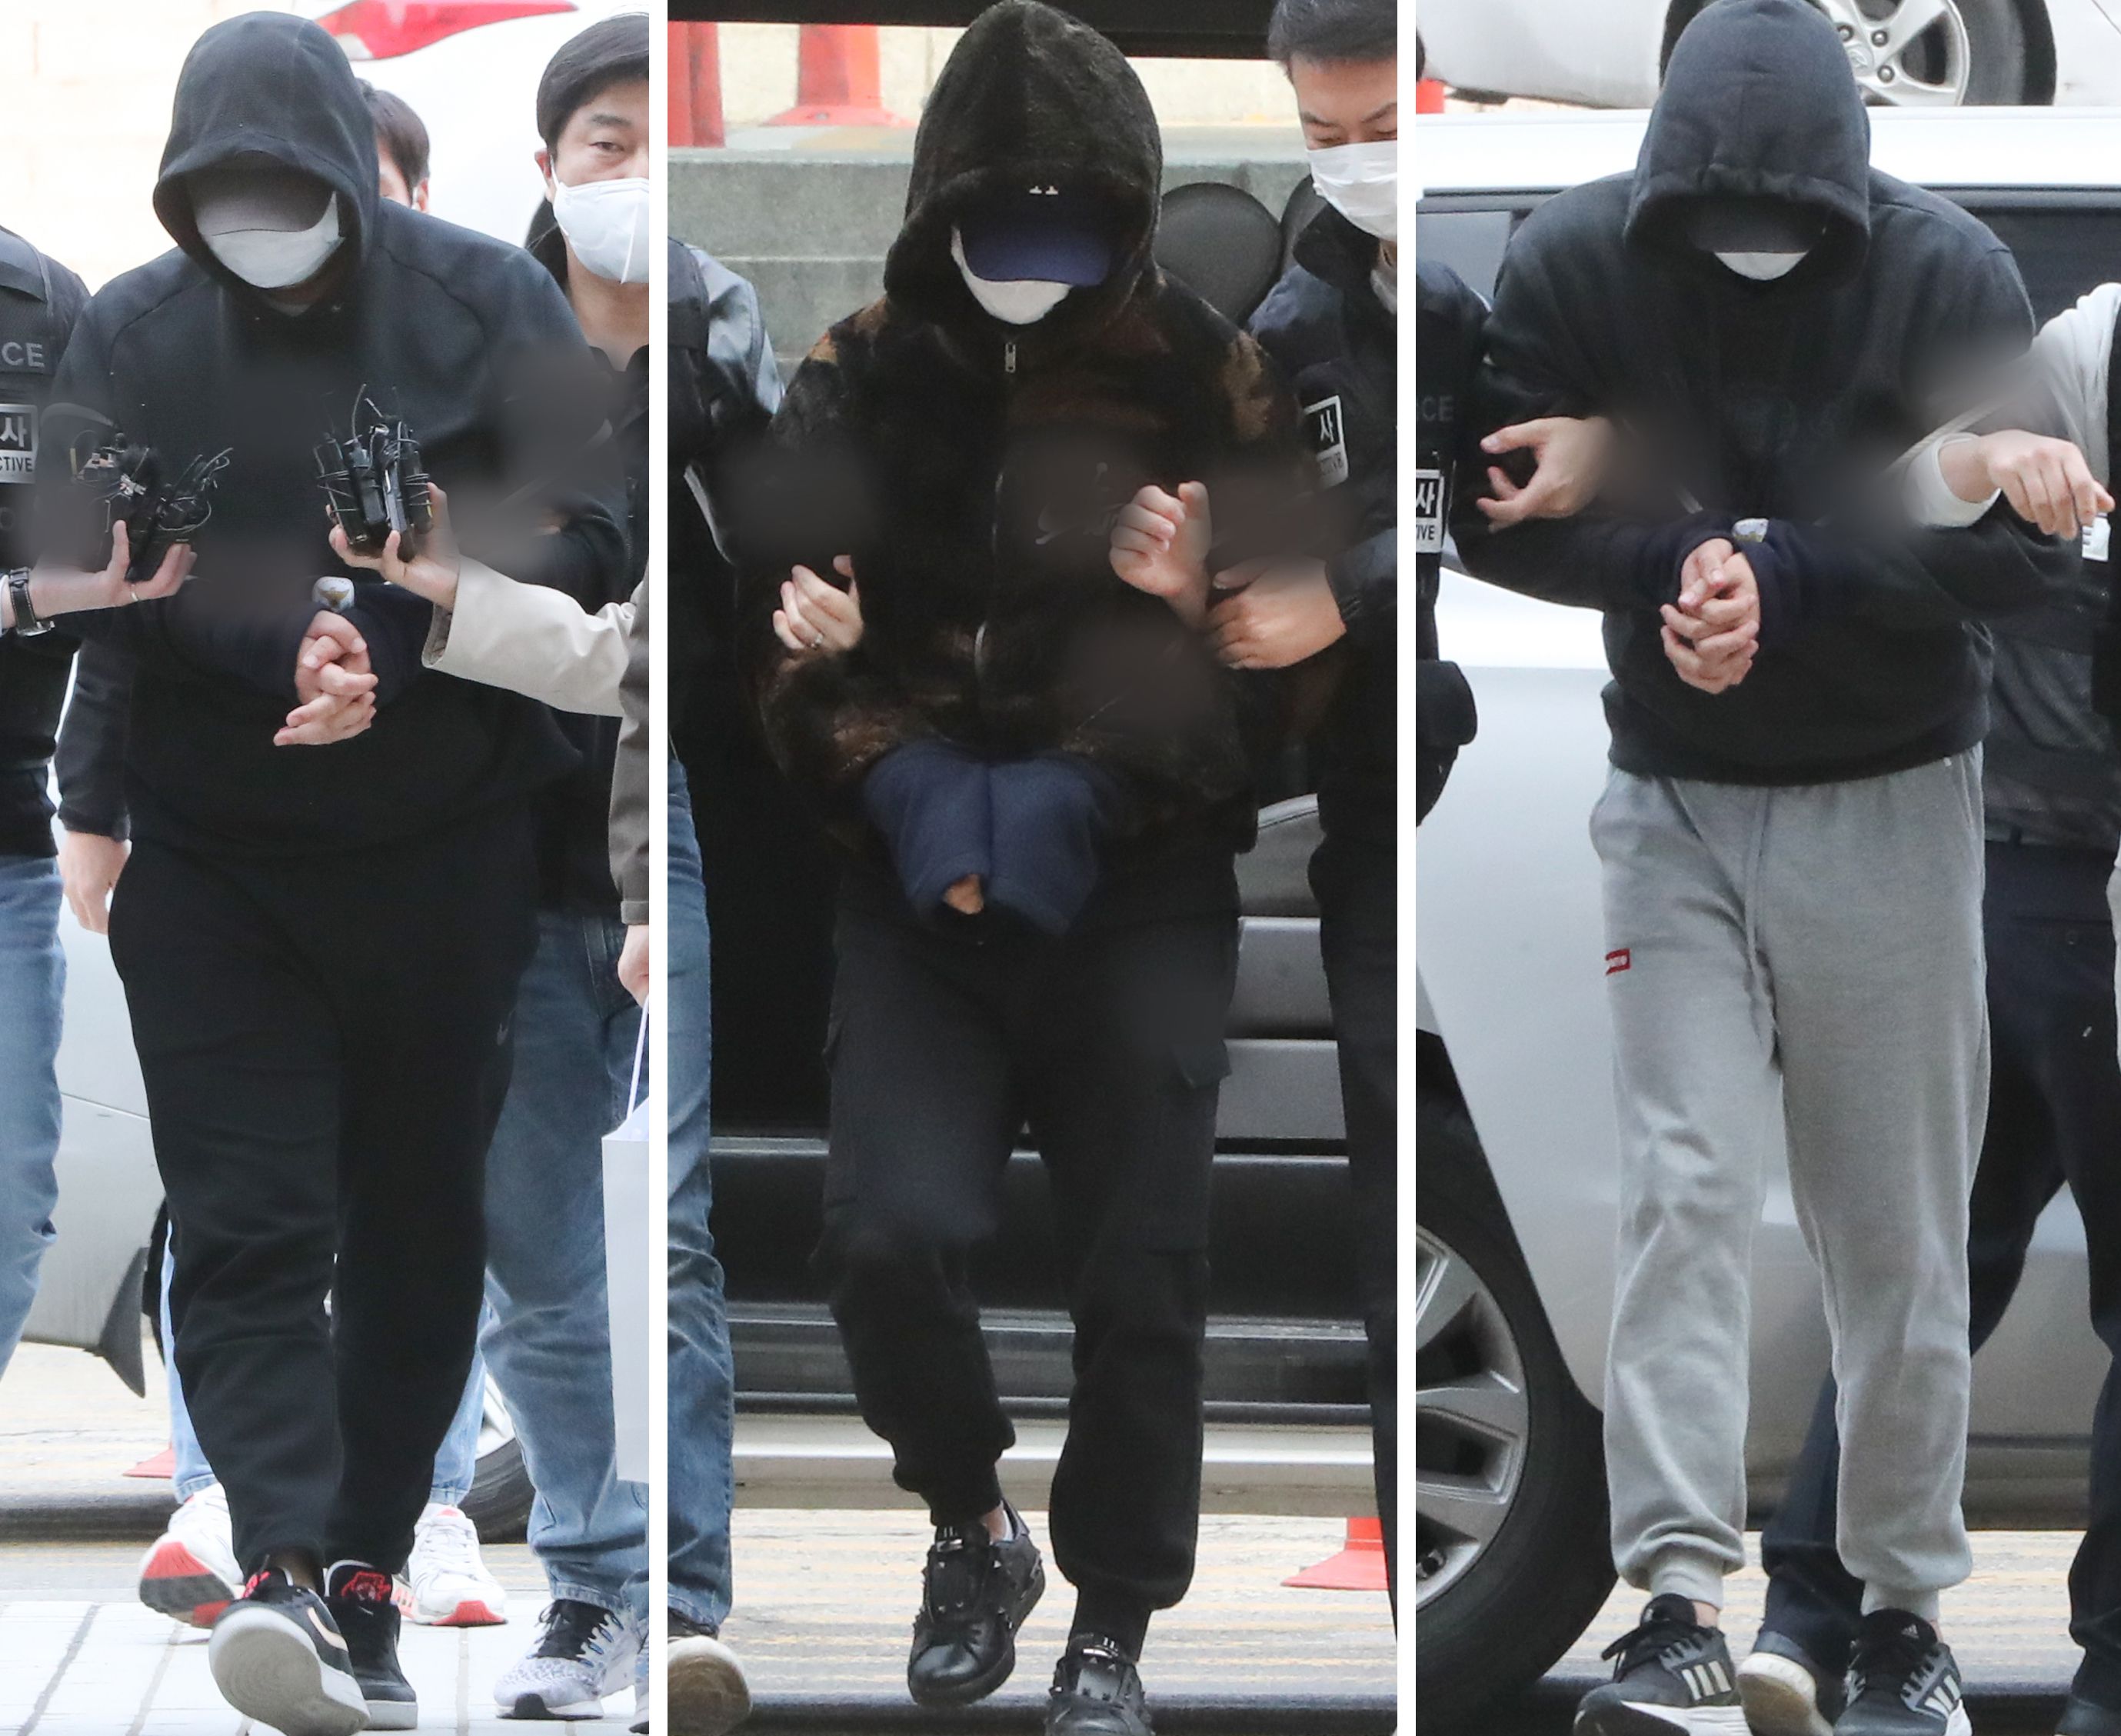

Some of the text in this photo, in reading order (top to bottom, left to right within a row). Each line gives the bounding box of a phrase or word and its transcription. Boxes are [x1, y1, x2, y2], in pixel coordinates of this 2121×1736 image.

[2, 342, 45, 368] CE
[0, 415, 28, 448] 사
[1320, 409, 1334, 443] 사
